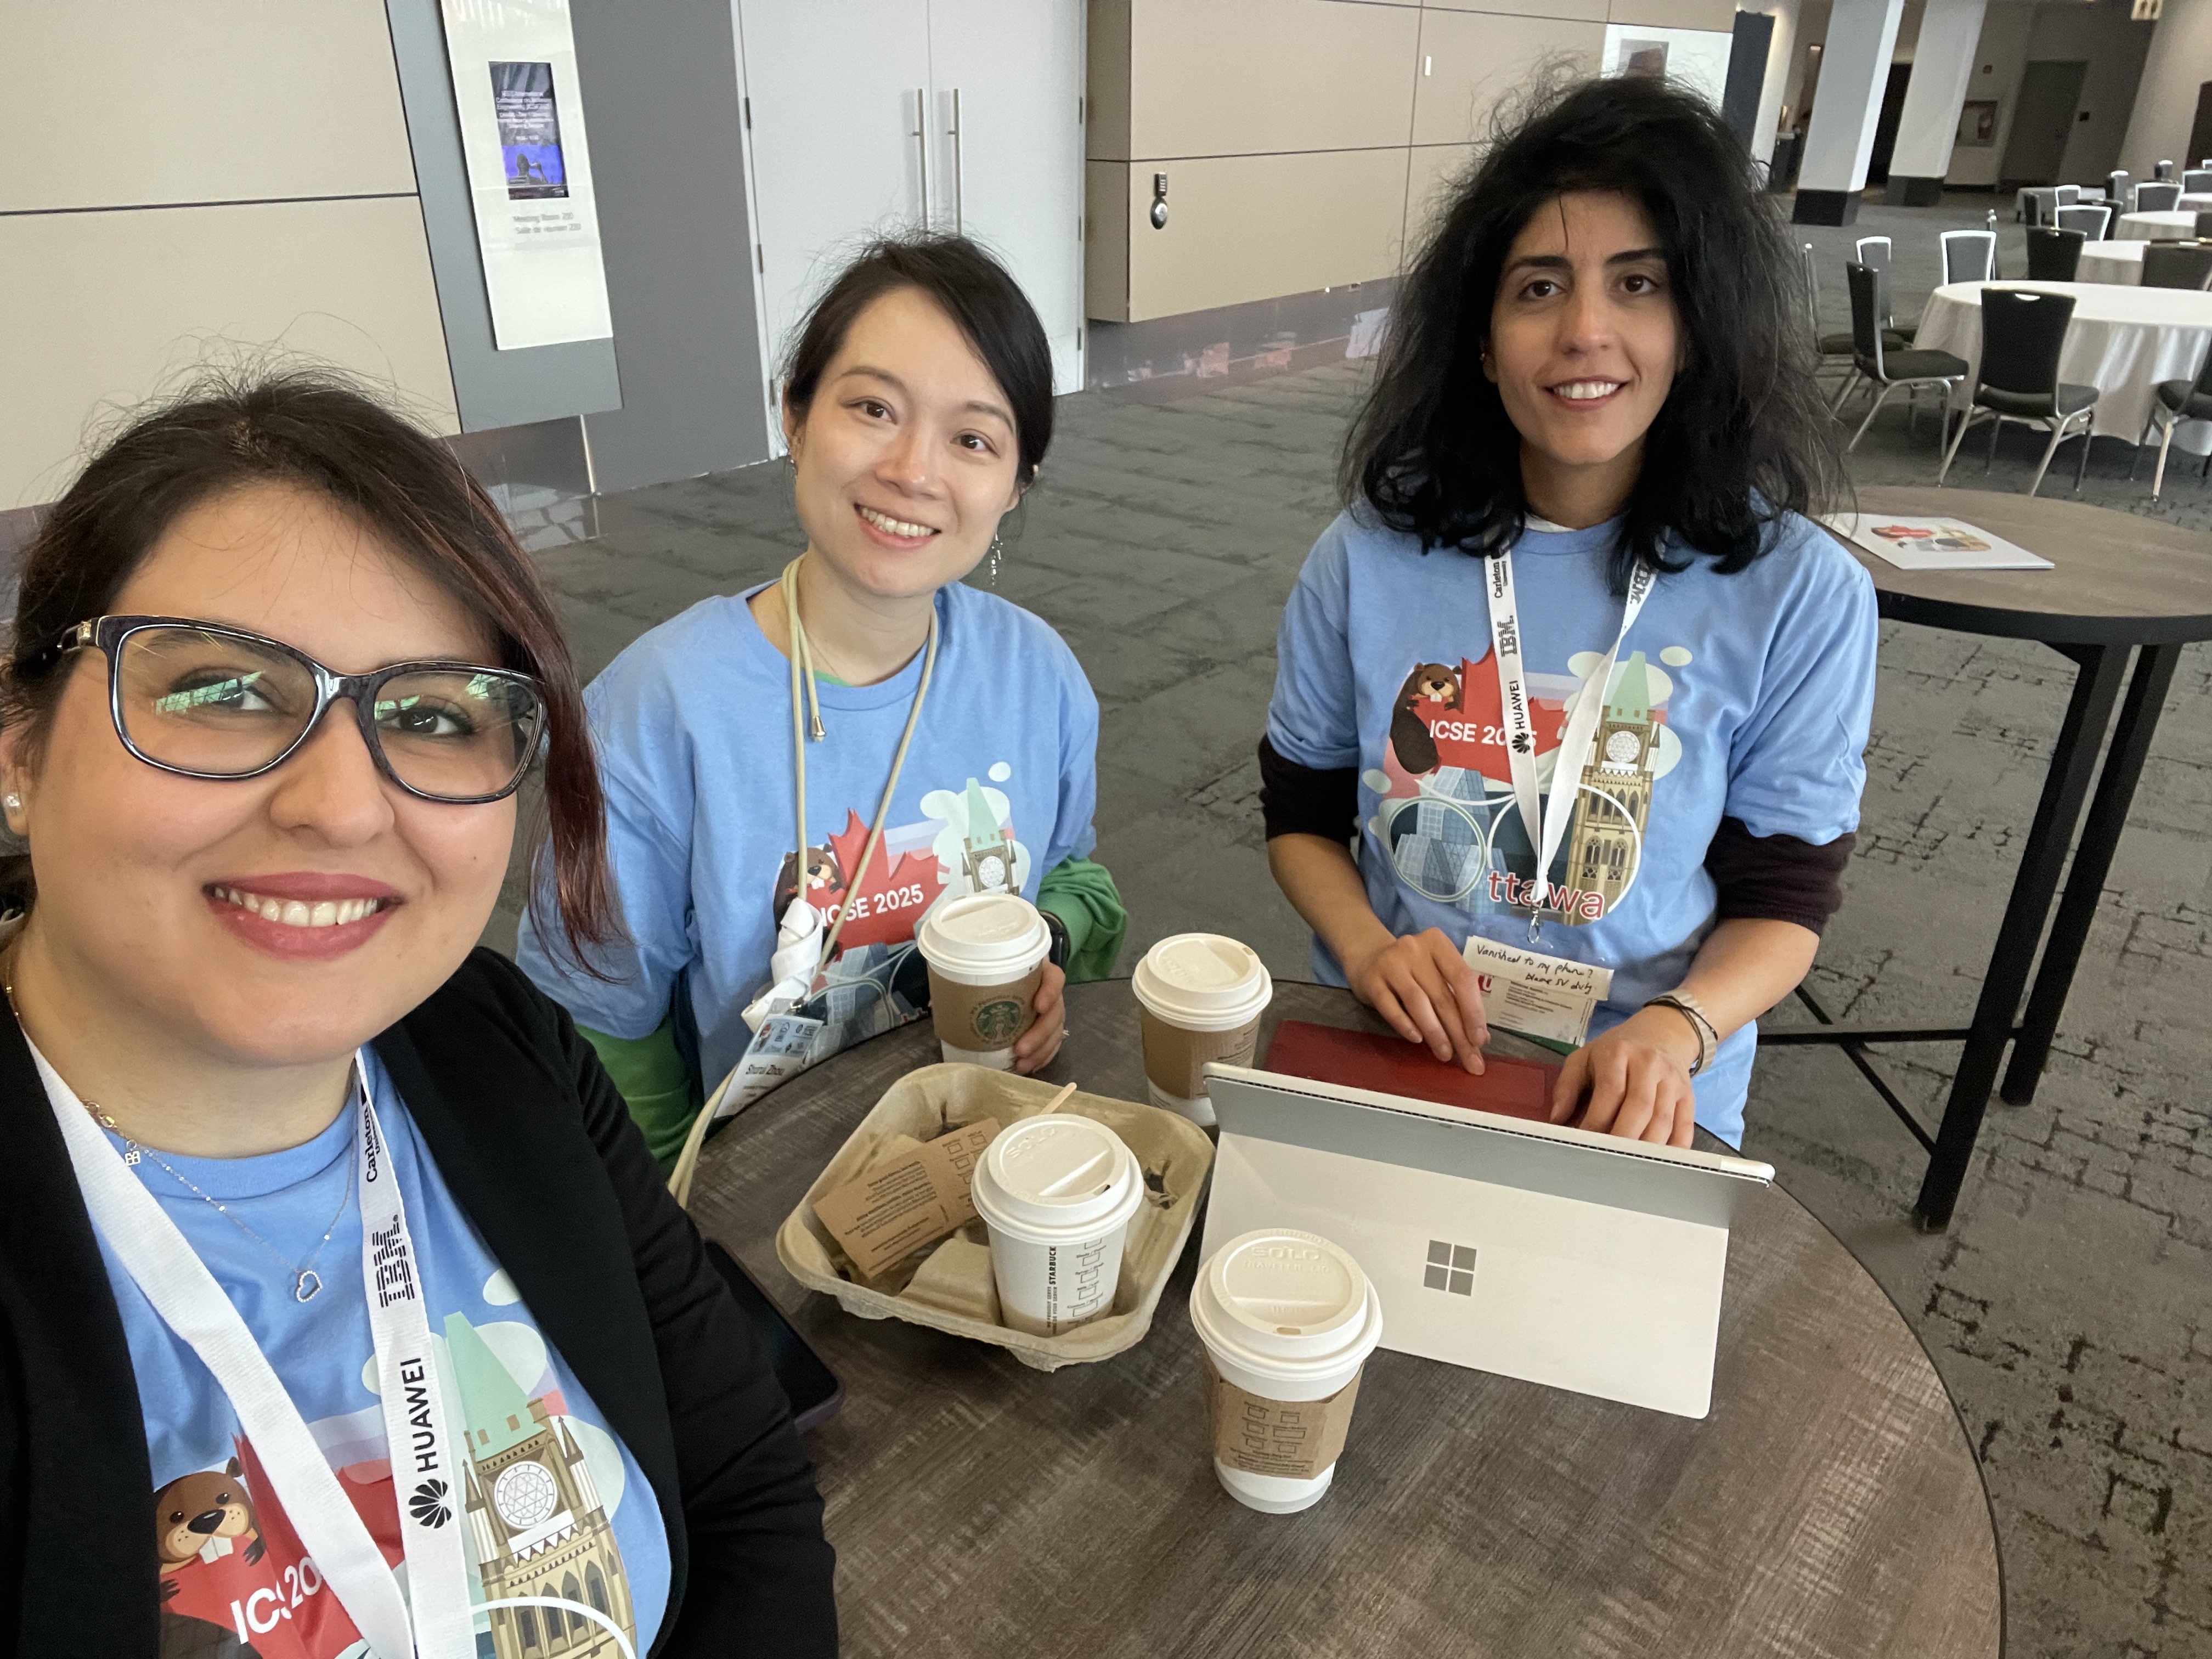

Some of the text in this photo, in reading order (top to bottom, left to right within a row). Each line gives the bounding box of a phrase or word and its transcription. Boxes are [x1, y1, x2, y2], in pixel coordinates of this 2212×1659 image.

[1493, 561, 1503, 599] Carleton
[1497, 616, 1517, 657] IBM
[1509, 680, 1526, 730] HUAWEI
[1430, 719, 1537, 747] ICSE 20
[874, 883, 924, 914] 2025
[1477, 944, 1521, 963] Vanished
[1525, 957, 1534, 966] to
[364, 1105, 377, 1182] Carleton
[372, 1215, 415, 1308] IBM
[1251, 1245, 1321, 1261] SOLO
[400, 1358, 438, 1472] HUAWEI
[230, 1556, 323, 1645] IC 20
